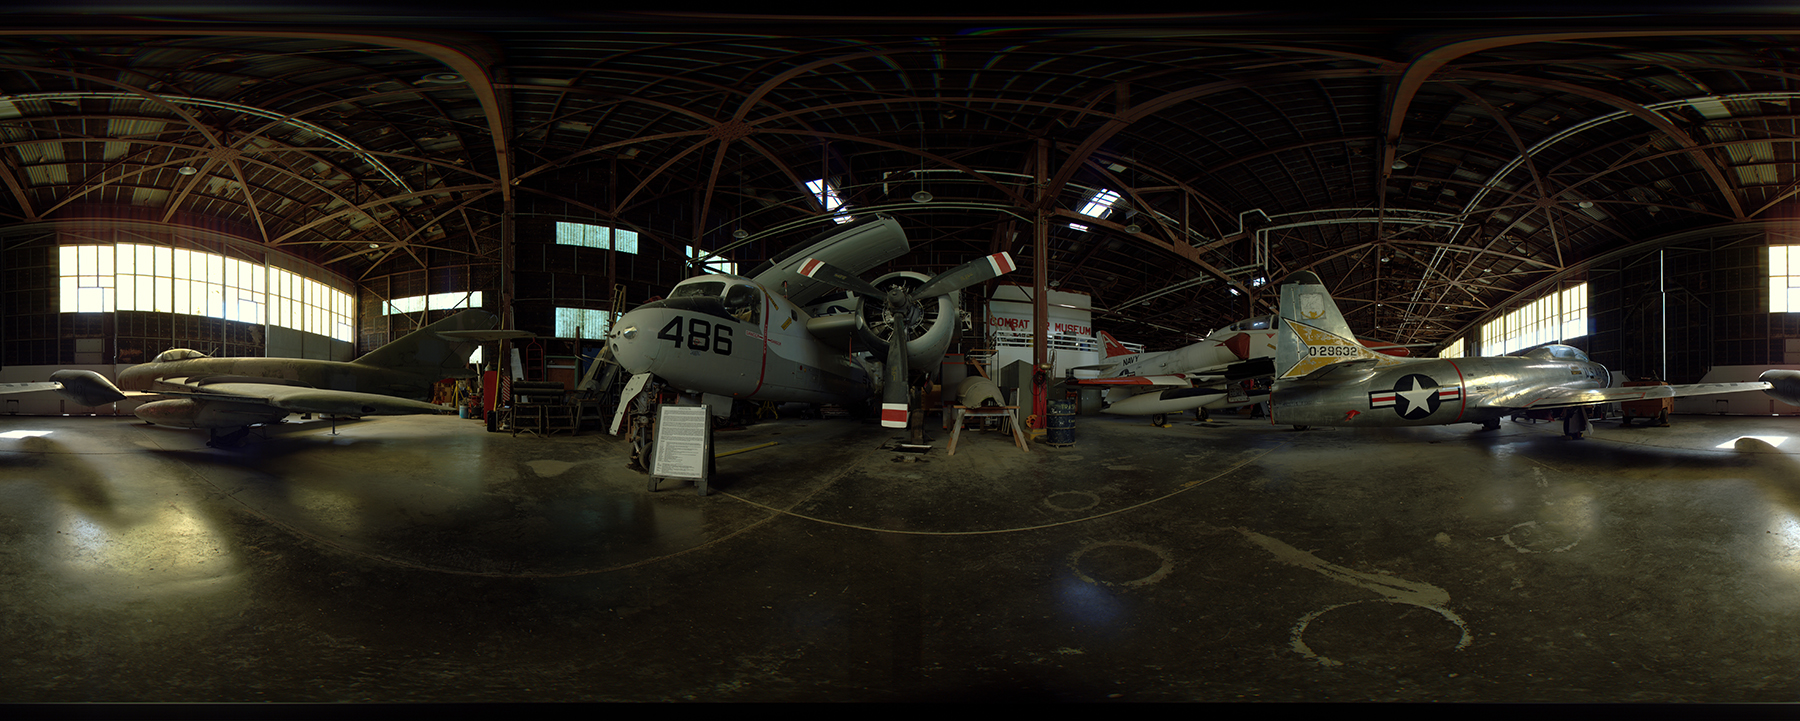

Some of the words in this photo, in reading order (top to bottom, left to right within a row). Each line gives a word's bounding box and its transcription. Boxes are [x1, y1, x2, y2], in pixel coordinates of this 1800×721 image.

[658, 315, 734, 355] 486
[990, 317, 1030, 329] COMBAT
[1055, 322, 1091, 336] MUSEUM
[1123, 354, 1140, 367] NAVY
